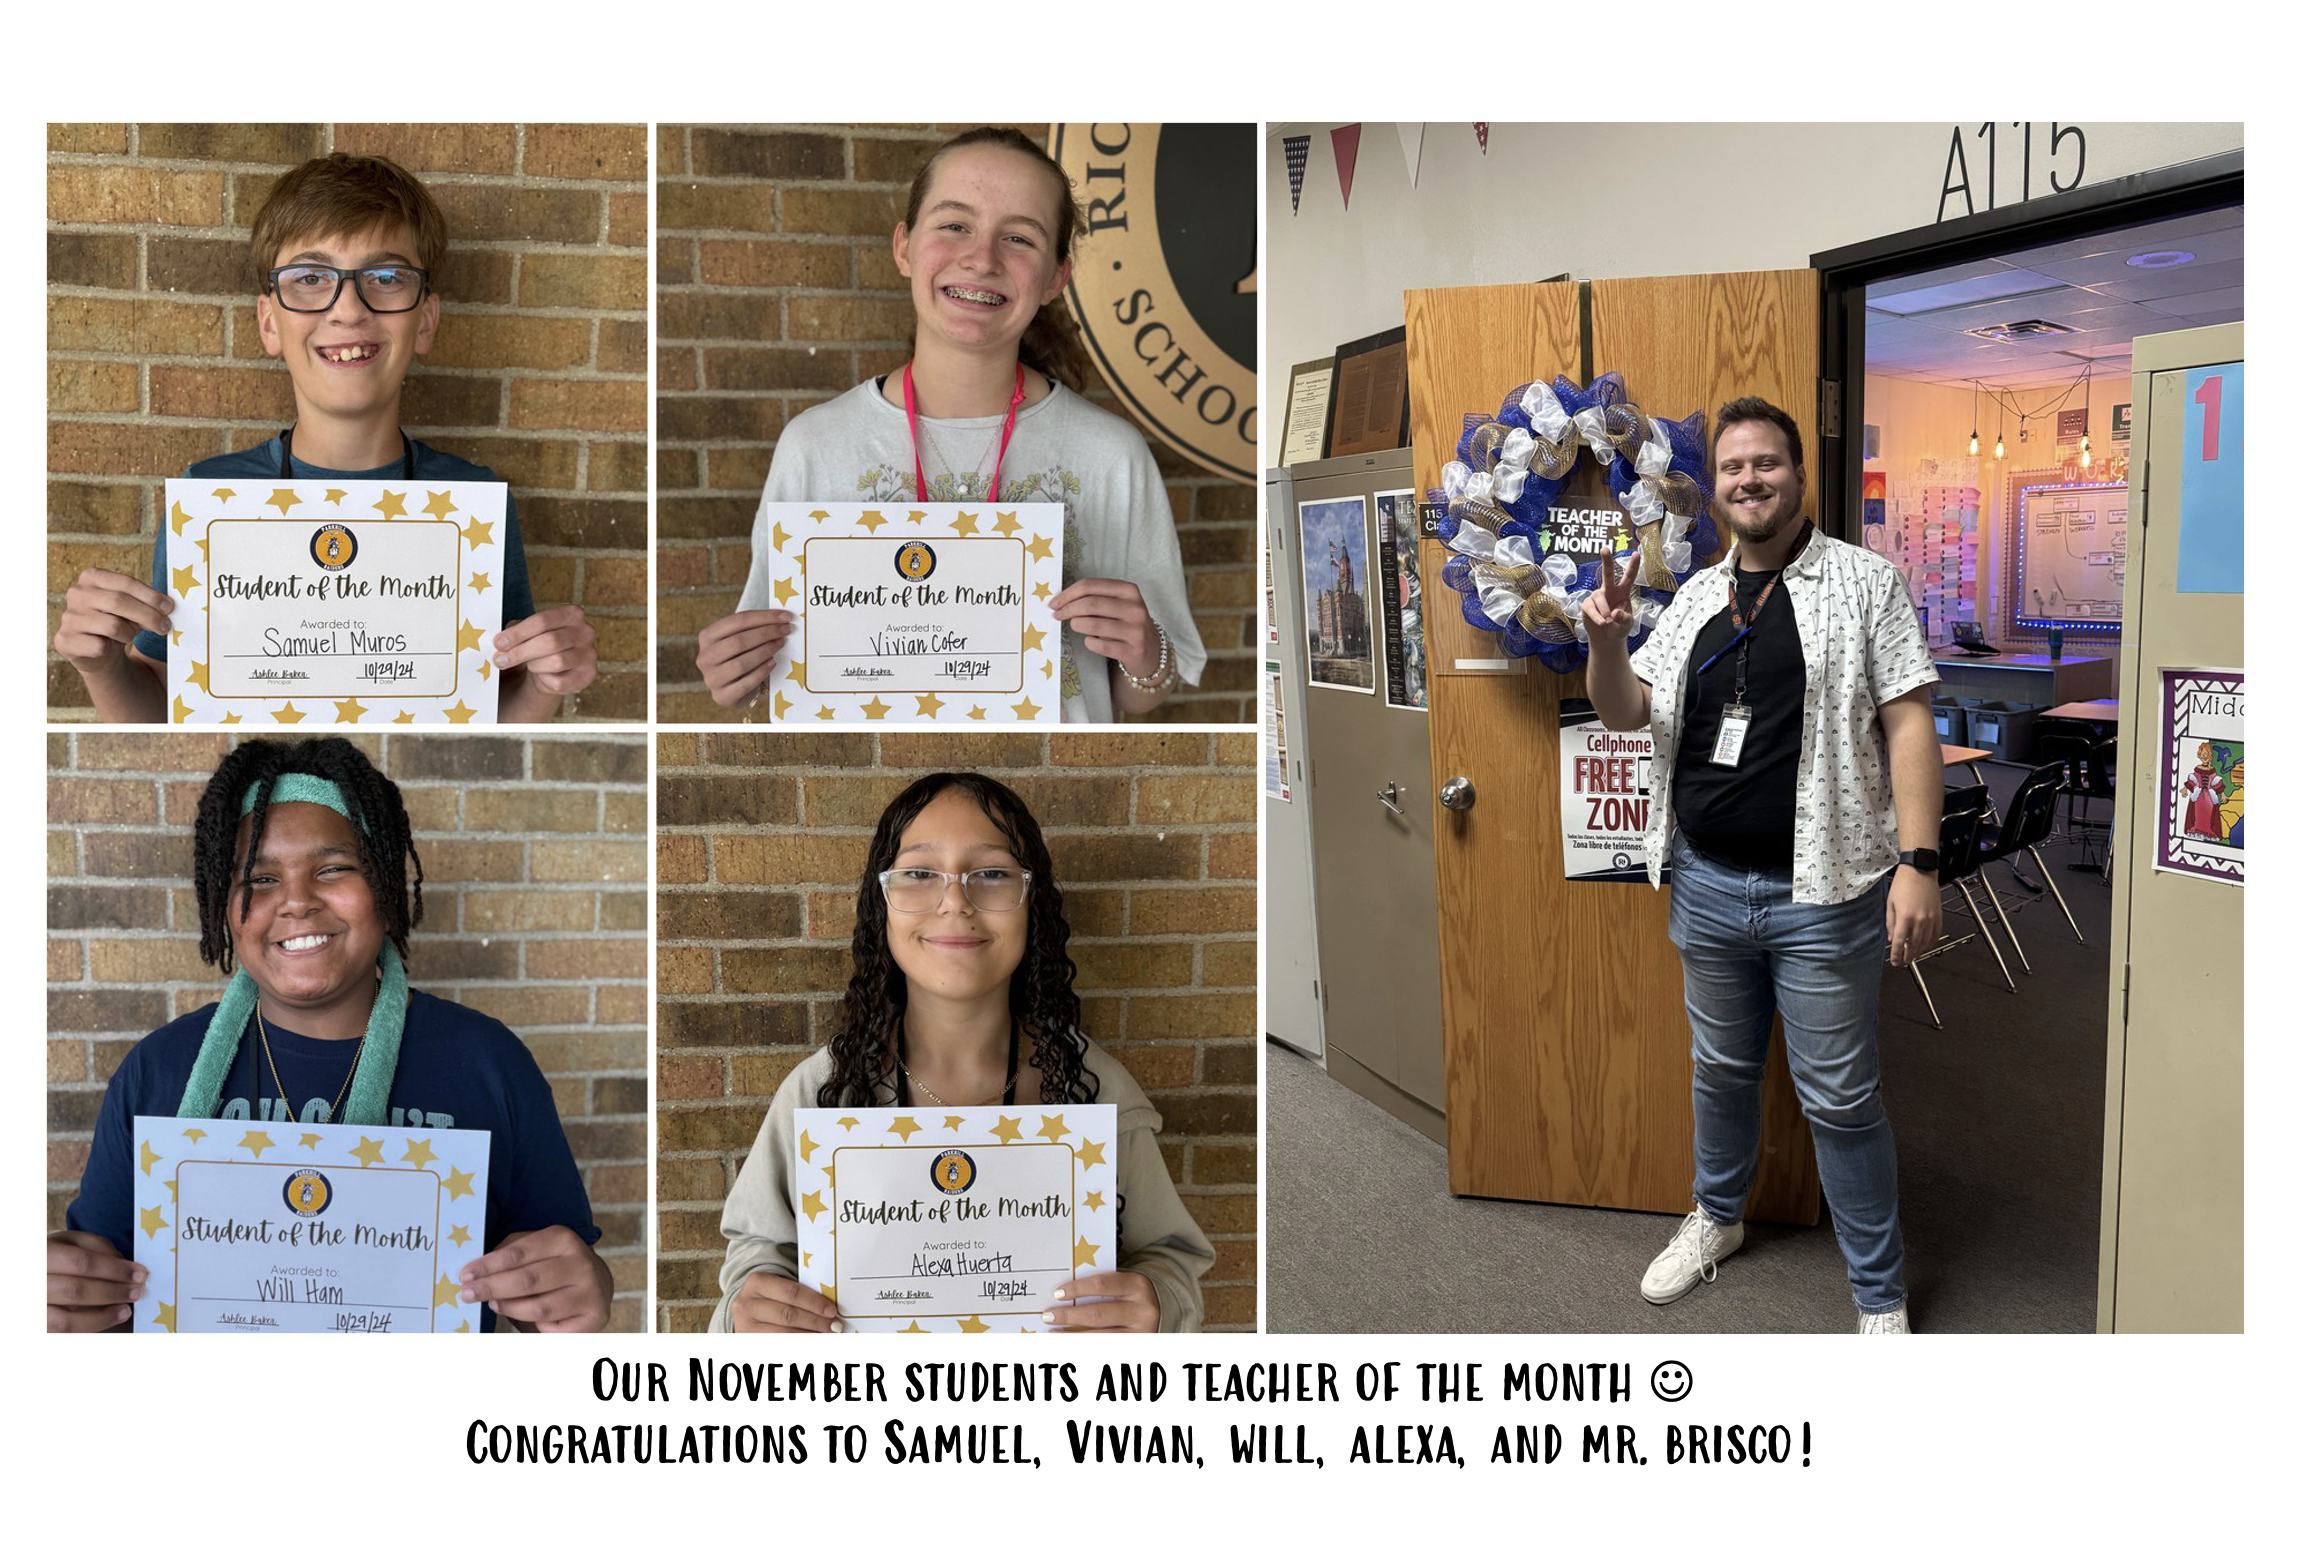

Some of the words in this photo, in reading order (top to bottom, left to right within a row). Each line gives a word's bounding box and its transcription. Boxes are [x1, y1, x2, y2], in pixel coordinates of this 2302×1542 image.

[1936, 122, 2086, 224] A115
[1548, 507, 1623, 526] TEACHER
[1562, 524, 1580, 536] OF
[1584, 526, 1608, 538] THE
[1554, 536, 1614, 554] MONTH
[214, 574, 304, 600] Student
[307, 576, 330, 600] of
[335, 574, 372, 598] the
[381, 575, 456, 599] Month
[809, 585, 889, 608] Student
[891, 586, 912, 608] of
[916, 584, 949, 606] the
[955, 585, 1021, 606] Month
[300, 619, 349, 630] Awarded
[352, 620, 367, 631] to:
[886, 624, 929, 633] Awarded
[931, 624, 945, 634] to:
[262, 627, 337, 658] Samuel
[351, 631, 407, 655] Muros
[870, 632, 928, 656] Vivian
[931, 631, 969, 651] Cofer
[364, 661, 414, 683] 10/29/24
[945, 660, 991, 680] 10/29/24
[1587, 734, 1651, 757] Cellphone
[1574, 757, 1635, 795] FREE
[1573, 840, 1588, 849] Zona
[1589, 841, 1602, 850] libre
[1604, 841, 1612, 850] de
[1613, 842, 1642, 851] teléfonos
[839, 1199, 925, 1224] Student
[928, 1199, 951, 1223] of
[955, 1197, 991, 1220] the
[999, 1195, 1071, 1218] Month
[182, 1216, 276, 1244] Student
[279, 1221, 302, 1247] of
[309, 1220, 347, 1245] the
[354, 1223, 435, 1251] Month
[923, 1241, 970, 1252] Awarded
[973, 1240, 987, 1251] to:
[270, 1264, 324, 1277] Awarded
[326, 1266, 340, 1278] to:
[911, 1253, 952, 1277] Alexa
[957, 1251, 1012, 1274] Huerta
[256, 1278, 294, 1303] Will
[305, 1278, 343, 1305] Ham
[983, 1280, 1028, 1301] 10/29/24
[336, 1311, 392, 1333] 10/29/24
